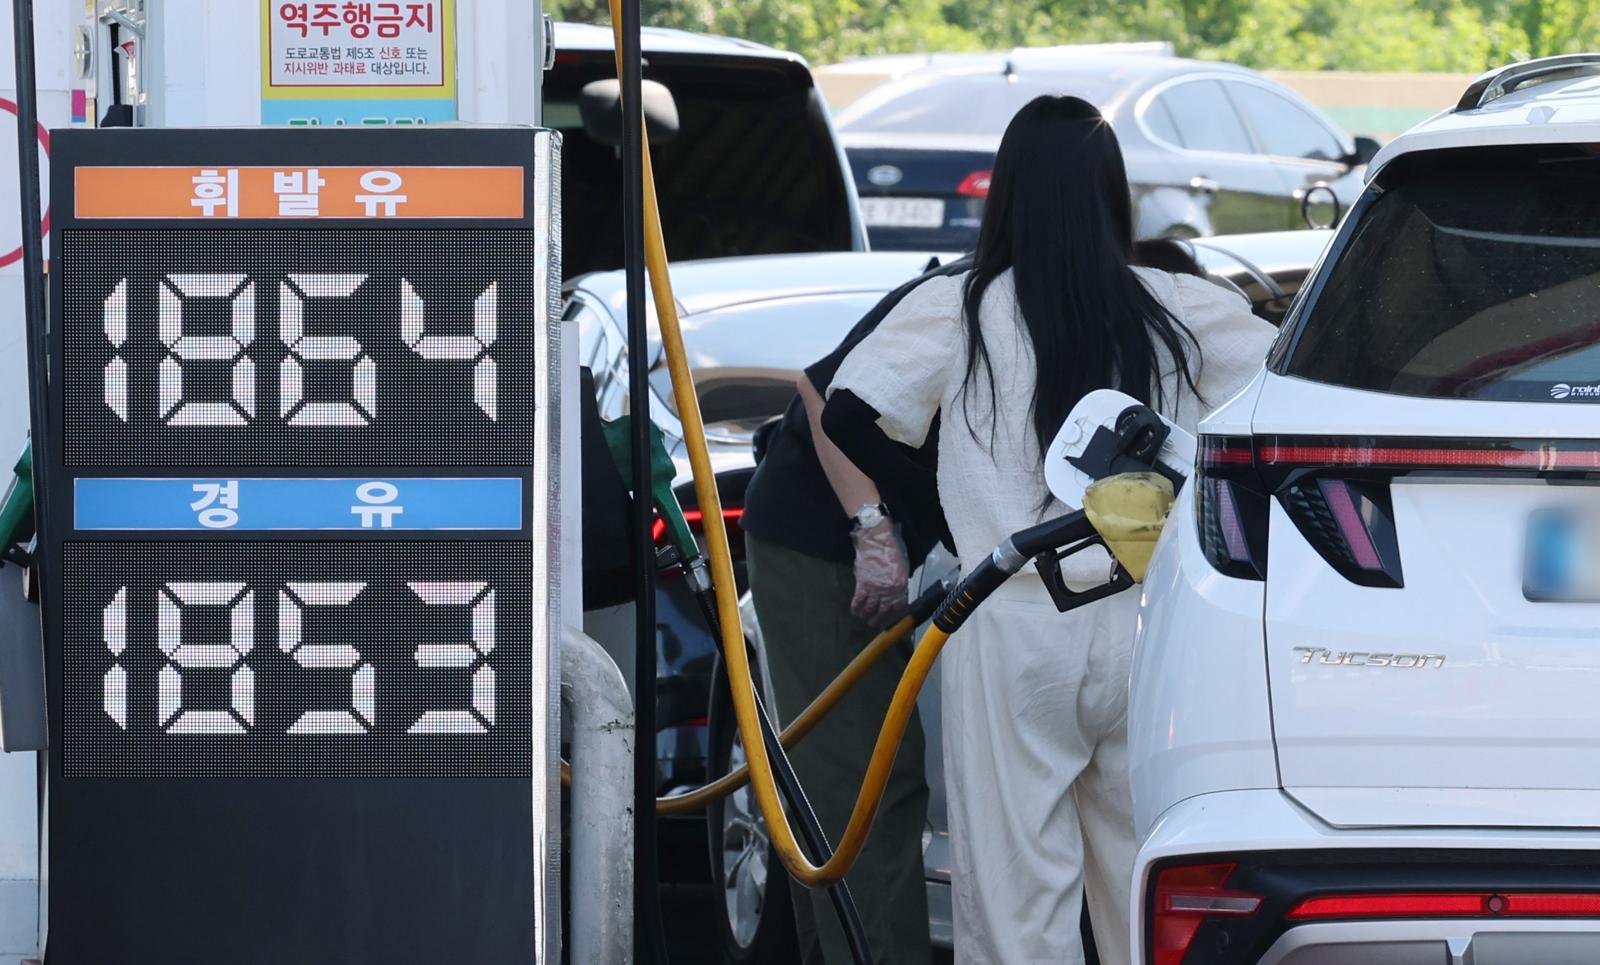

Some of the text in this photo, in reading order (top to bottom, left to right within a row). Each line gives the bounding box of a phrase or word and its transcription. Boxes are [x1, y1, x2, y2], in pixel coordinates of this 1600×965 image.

[279, 2, 434, 39] 역주행금지
[283, 62, 430, 75] 지시위반 과태료 대상입니다.
[285, 47, 428, 60] 도로교통법 제5조 신호 또는
[103, 272, 499, 426] 1864
[103, 581, 497, 735] 1853
